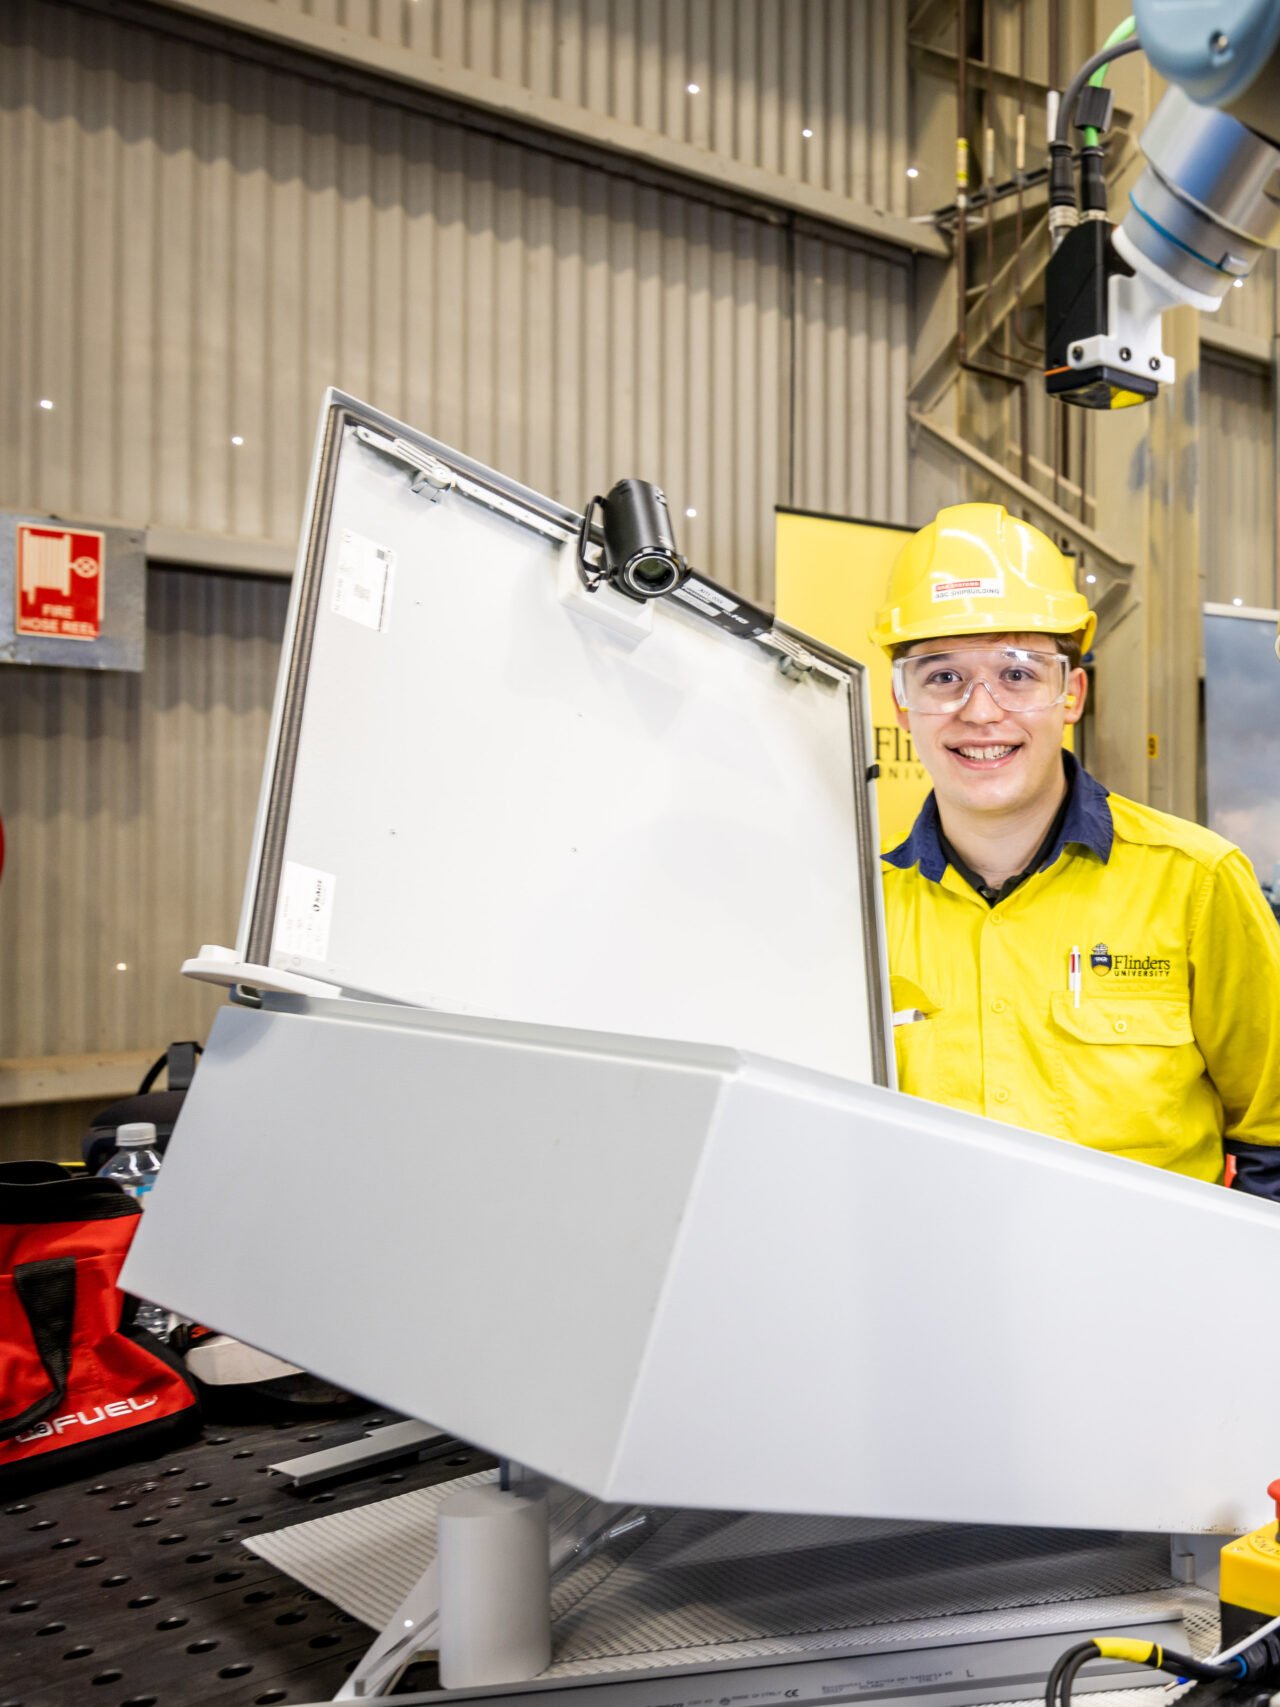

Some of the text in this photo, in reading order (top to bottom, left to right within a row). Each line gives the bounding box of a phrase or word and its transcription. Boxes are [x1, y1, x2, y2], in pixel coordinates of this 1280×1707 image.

[42, 604, 74, 619] FIRE
[20, 618, 97, 636] HOSE REEL
[875, 727, 920, 762] Fli
[1114, 955, 1171, 970] Flinders
[52, 1396, 159, 1435] FUEL
[784, 1688, 799, 1698] CE
